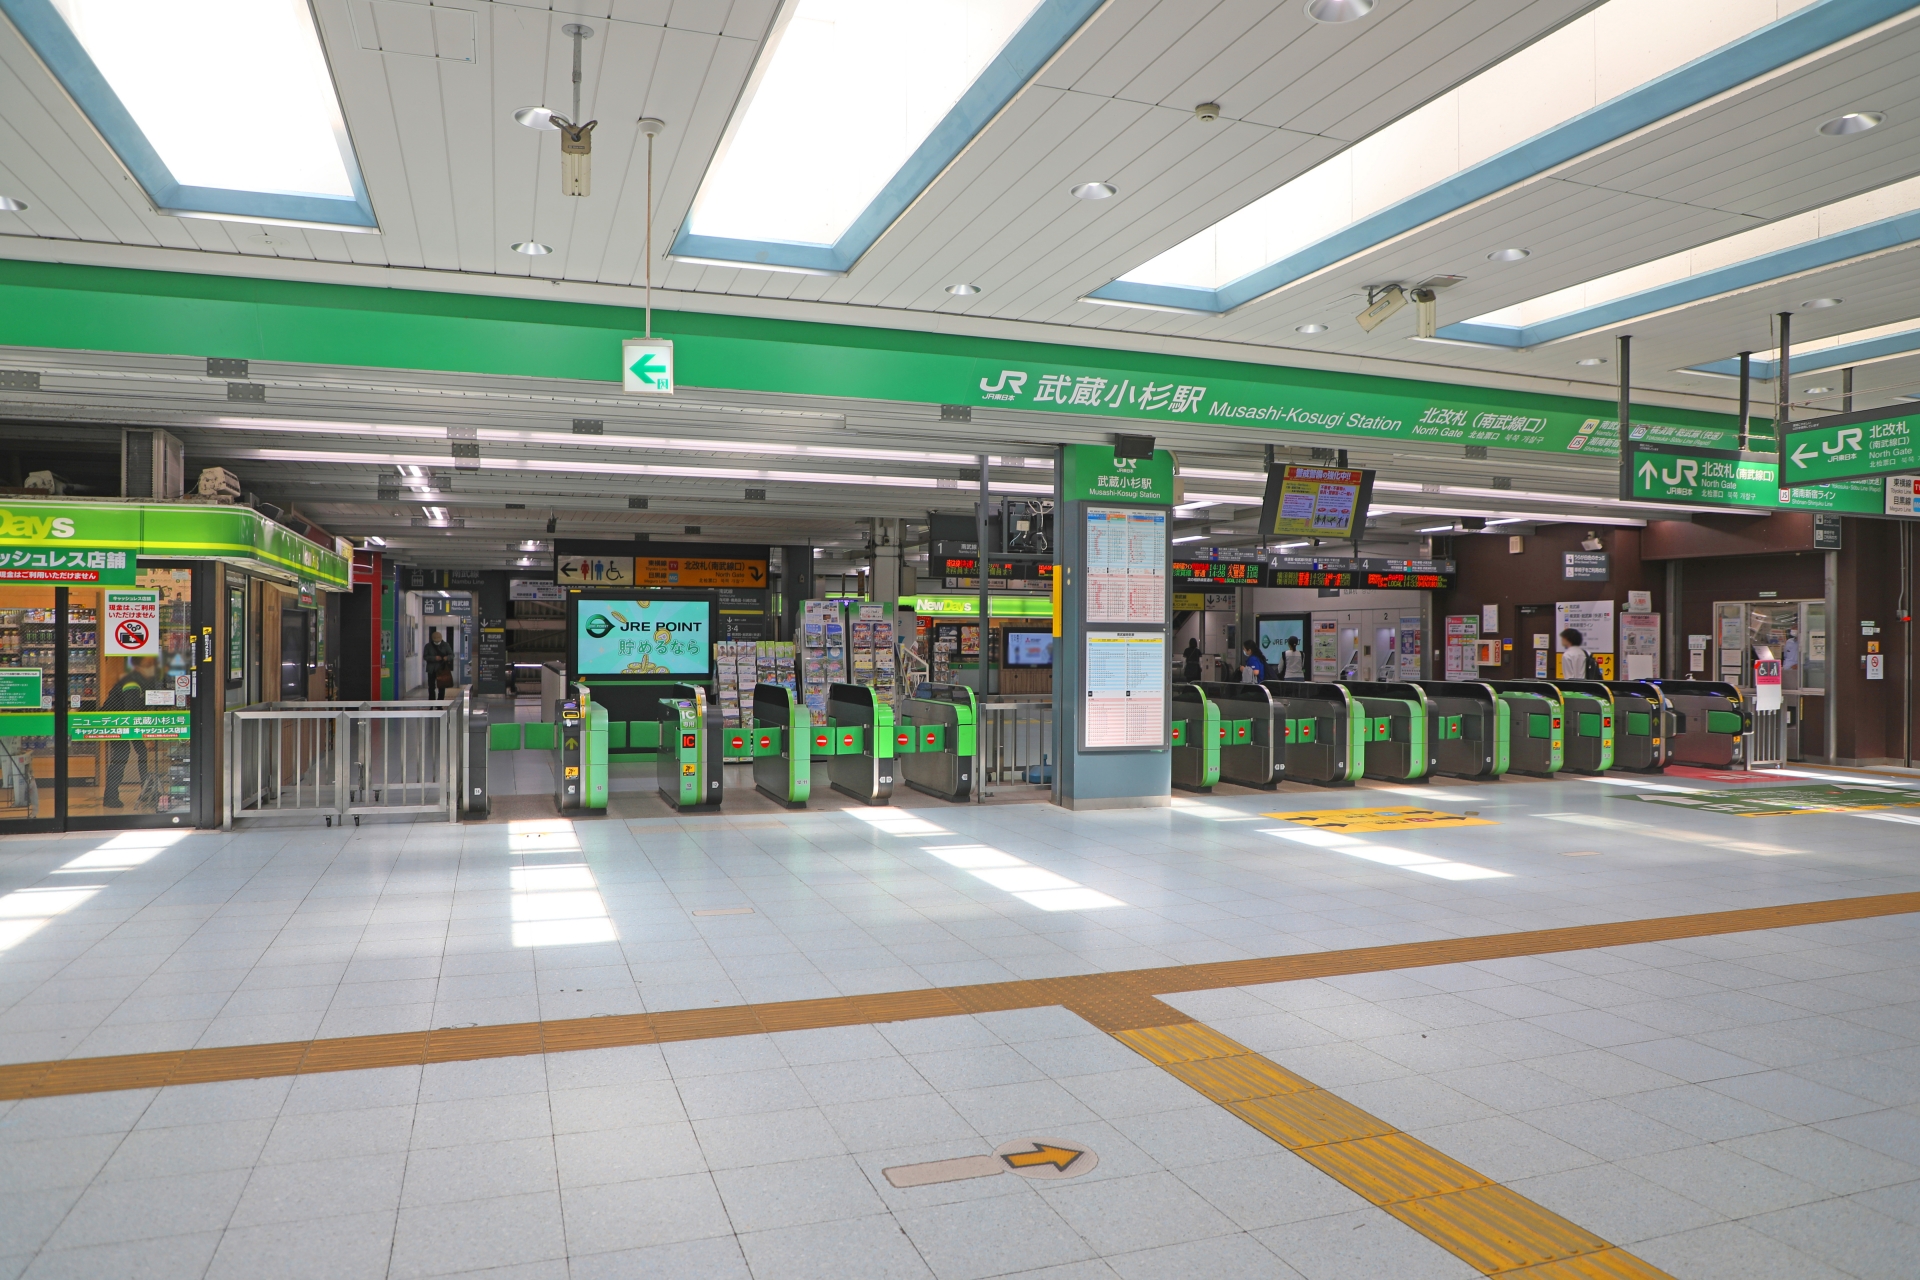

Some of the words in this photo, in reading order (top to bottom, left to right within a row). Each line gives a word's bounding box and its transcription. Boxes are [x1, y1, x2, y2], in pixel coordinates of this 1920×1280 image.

[980, 370, 1027, 394] JR
[982, 393, 1015, 401] JR東日本
[1033, 374, 1207, 414] 武蔵小杉駅
[1208, 401, 1346, 429] Musashi-Kosugi
[1346, 413, 1402, 431] Station
[1599, 420, 1620, 431] 南武
[1869, 421, 1910, 439] 北改札
[1411, 425, 1438, 436] North
[1440, 427, 1463, 438] Gate
[1822, 428, 1863, 455] JR
[1869, 436, 1910, 450] (南武線口)
[1827, 453, 1858, 463] JR東日本
[1869, 449, 1891, 459] North
[1893, 447, 1913, 456] Gate
[1662, 459, 1698, 487] JR
[1701, 462, 1734, 478] 北改札
[1735, 469, 1775, 482] (南武線口)
[1098, 475, 1152, 489] 武蔵小杉駅
[1701, 478, 1720, 489] North
[1721, 480, 1737, 490] Gate
[1894, 478, 1911, 488] 東横線
[1089, 488, 1138, 498] Musashi-Kosugi
[1140, 491, 1160, 499] Station
[1667, 487, 1693, 496] JR東日本
[1792, 489, 1836, 500] 湘南新宿ライン
[1894, 496, 1911, 505] 目黒線
[938, 543, 943, 554] 1
[1209, 563, 1226, 571] 14:19
[1271, 556, 1278, 567] 4
[1362, 559, 1369, 569] 4
[109, 604, 155, 612] 現金は、ご利用
[437, 600, 442, 610] 1
[917, 599, 972, 611] NewDays
[620, 622, 651, 632] JRE
[656, 622, 702, 632] POINT
[481, 634, 485, 643] 1
[619, 639, 700, 655] 貯めるなら
[681, 710, 695, 719] IC
[72, 716, 130, 726] ニューデイズ
[133, 716, 185, 726] 武蔵小杉1号
[683, 736, 695, 747] IC
